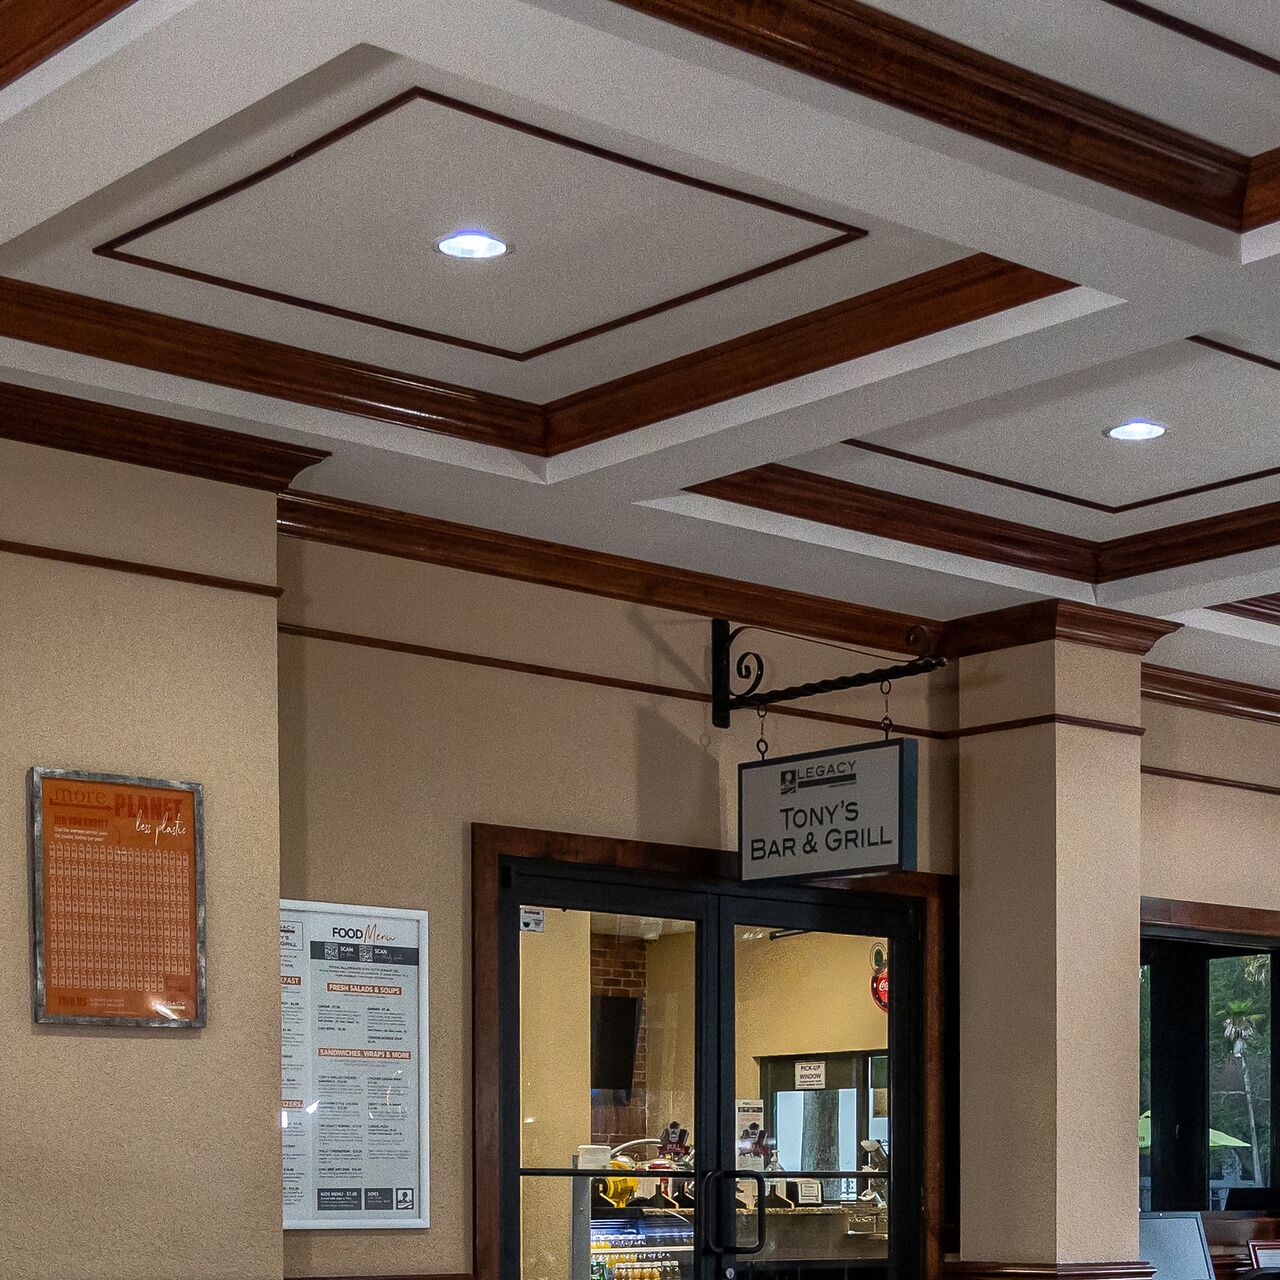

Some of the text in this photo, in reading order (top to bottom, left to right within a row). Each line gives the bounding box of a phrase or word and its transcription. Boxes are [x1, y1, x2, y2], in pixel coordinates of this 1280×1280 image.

[797, 760, 856, 780] LEGACY
[54, 788, 183, 821] more PLANET
[780, 800, 859, 830] TONY'S
[750, 826, 893, 861] BAR & GRILL
[332, 923, 397, 944] FOOD Menu
[328, 984, 349, 992] FRESH
[349, 985, 373, 993] SALADS
[380, 987, 401, 995] SOUPS
[363, 1050, 385, 1058] WRAPS
[391, 1051, 410, 1059] MORE
